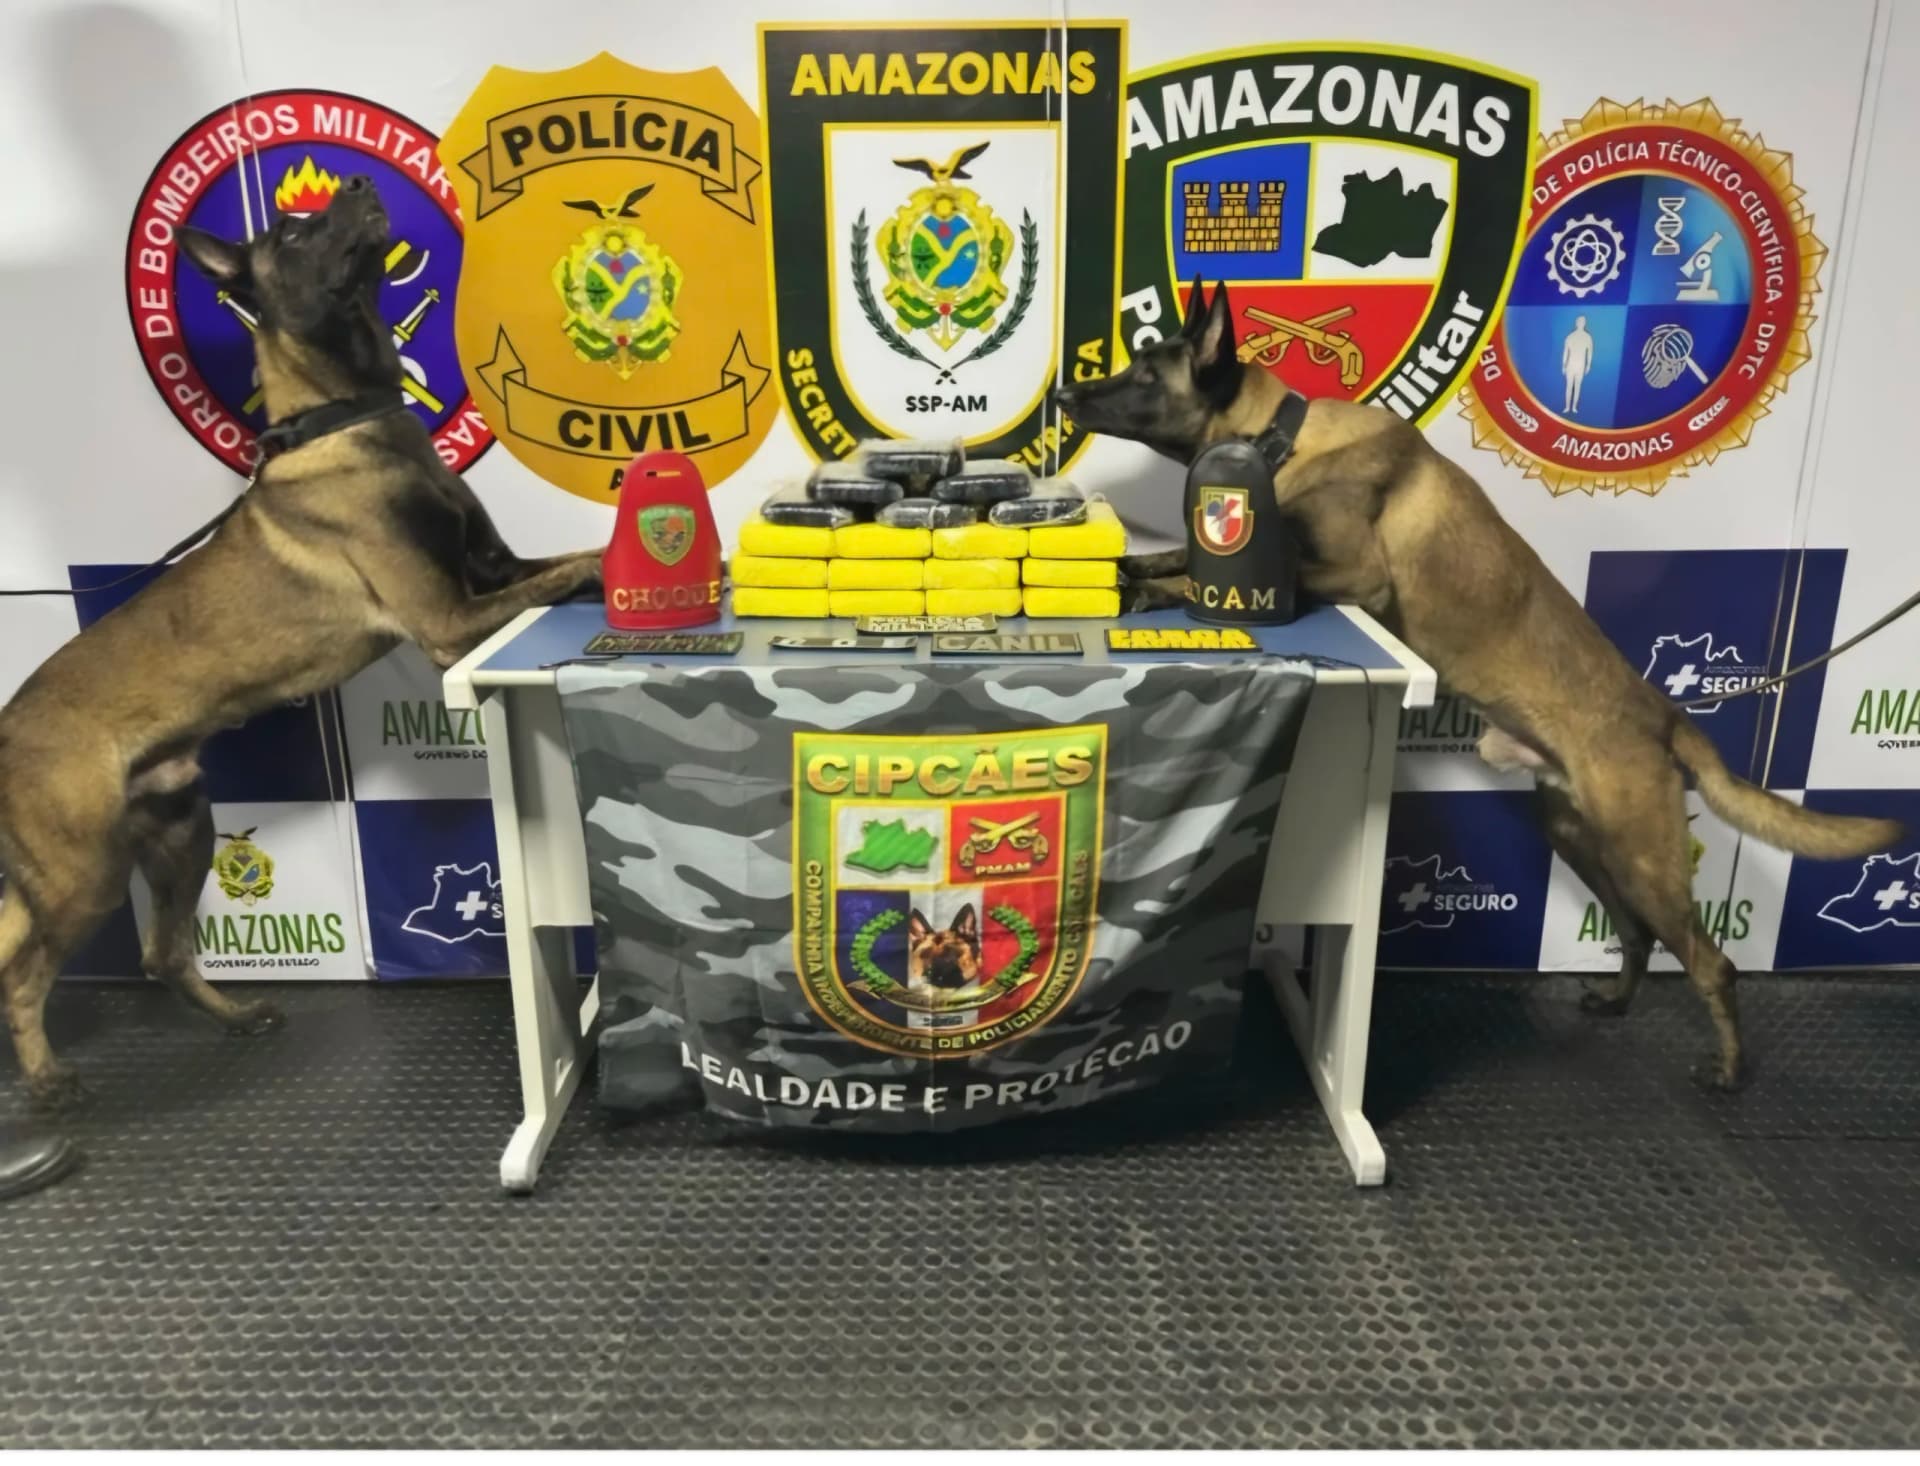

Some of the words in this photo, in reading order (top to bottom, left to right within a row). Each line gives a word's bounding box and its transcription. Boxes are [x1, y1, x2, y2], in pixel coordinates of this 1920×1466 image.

[789, 51, 1097, 96] AMAZONAS
[1125, 64, 1510, 159] AMAZONAS
[501, 100, 720, 173] POLÍCIA
[139, 104, 300, 275] BOMBEIROS
[1533, 175, 1562, 205] DE
[1563, 141, 1650, 183] POLÍCIA
[1657, 139, 1787, 304] TÉCNICO-CIENTÍFICA
[1738, 322, 1777, 380] DPTC
[140, 287, 174, 338] DE
[1368, 290, 1484, 420] ilitar
[158, 352, 265, 466] CORPO
[788, 348, 858, 456] SECRET
[905, 395, 988, 412] SSP-AM
[558, 409, 712, 453] CIVIL
[1552, 432, 1674, 462] AMAZONAS
[612, 580, 721, 612] CHOQUE
[938, 635, 1075, 651] CANIL
[807, 746, 1094, 795] CIPCÃES
[976, 861, 1032, 876] PMAM
[1434, 893, 1519, 911] SEGURO
[192, 913, 346, 956] MAZONAS
[938, 1036, 964, 1049] DE
[681, 1041, 907, 1113] LEALDADE
[923, 1086, 949, 1114] E
[964, 1019, 1192, 1110] PROTEÇÃO
